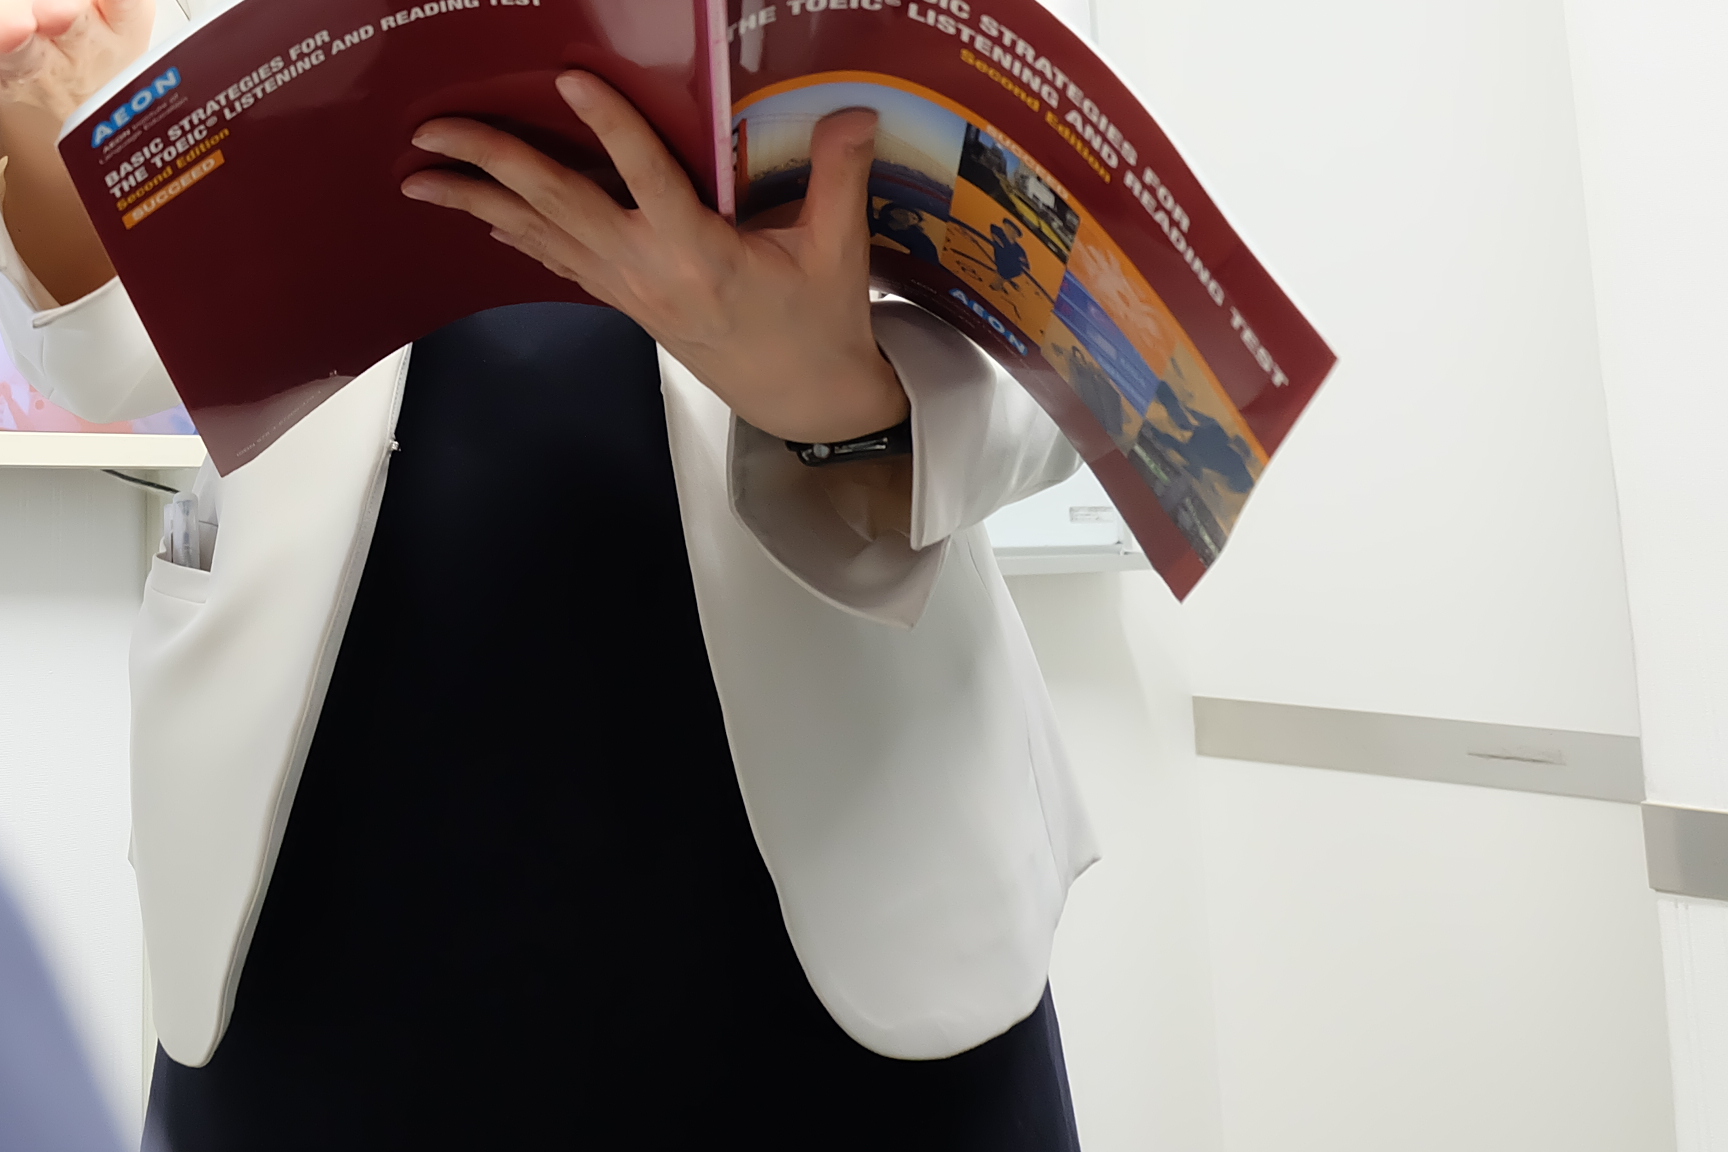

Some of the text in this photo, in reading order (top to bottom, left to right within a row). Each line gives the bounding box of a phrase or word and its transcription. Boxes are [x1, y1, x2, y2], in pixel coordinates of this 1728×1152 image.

[91, 66, 181, 148] AEON
[104, 29, 331, 188] BASIC STRATEGIES FOR
[110, 165, 149, 198] THE
[223, 50, 325, 121] LISTENING
[330, 25, 374, 55] AND
[116, 128, 230, 212] Second Edition
[960, 48, 1111, 184] Second Edition
[979, 14, 1138, 167] STRATEGIES
[1142, 166, 1190, 233] FOR
[131, 157, 216, 222] SUCCEED
[907, 3, 1059, 109] LISTENING
[1064, 109, 1119, 169] AND
[1124, 169, 1225, 307] READING
[1229, 305, 1289, 388] TEST
[949, 287, 1029, 356] AEON
